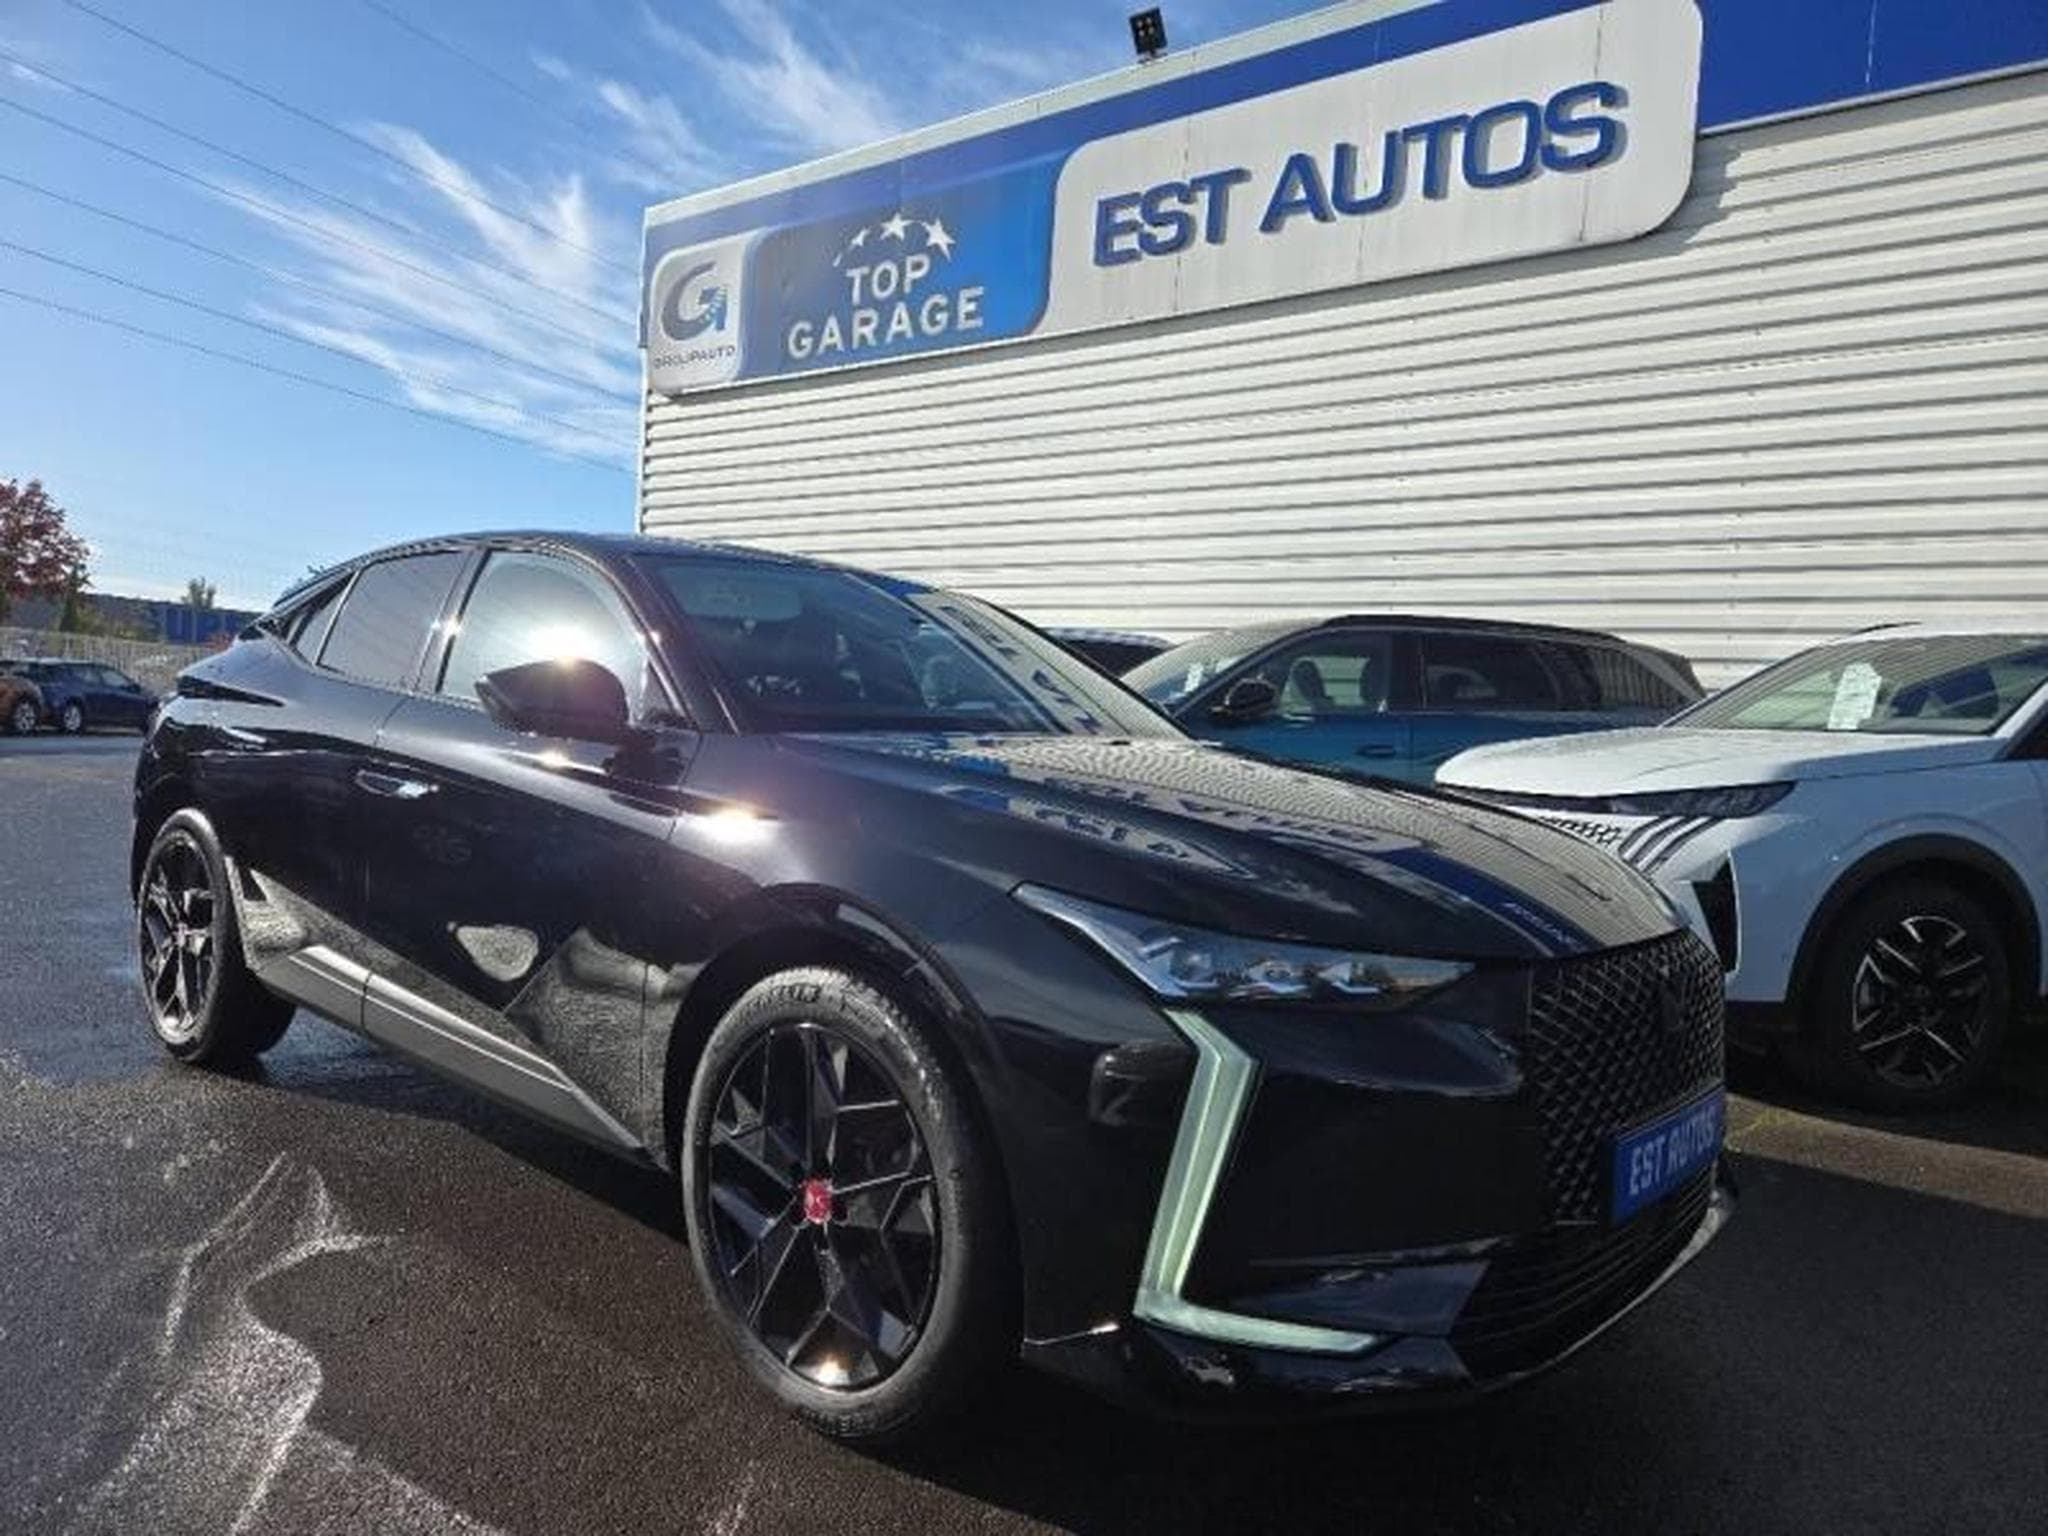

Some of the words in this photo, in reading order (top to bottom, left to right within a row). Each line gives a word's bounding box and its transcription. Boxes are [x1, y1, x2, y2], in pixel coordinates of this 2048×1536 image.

[1093, 167, 1252, 267] EST
[1259, 81, 1630, 233] AUTOS
[846, 254, 931, 305] TOP
[787, 286, 985, 360] GARAGE
[1629, 1134, 1666, 1195] EST
[1666, 1105, 1715, 1175] AUTOS
